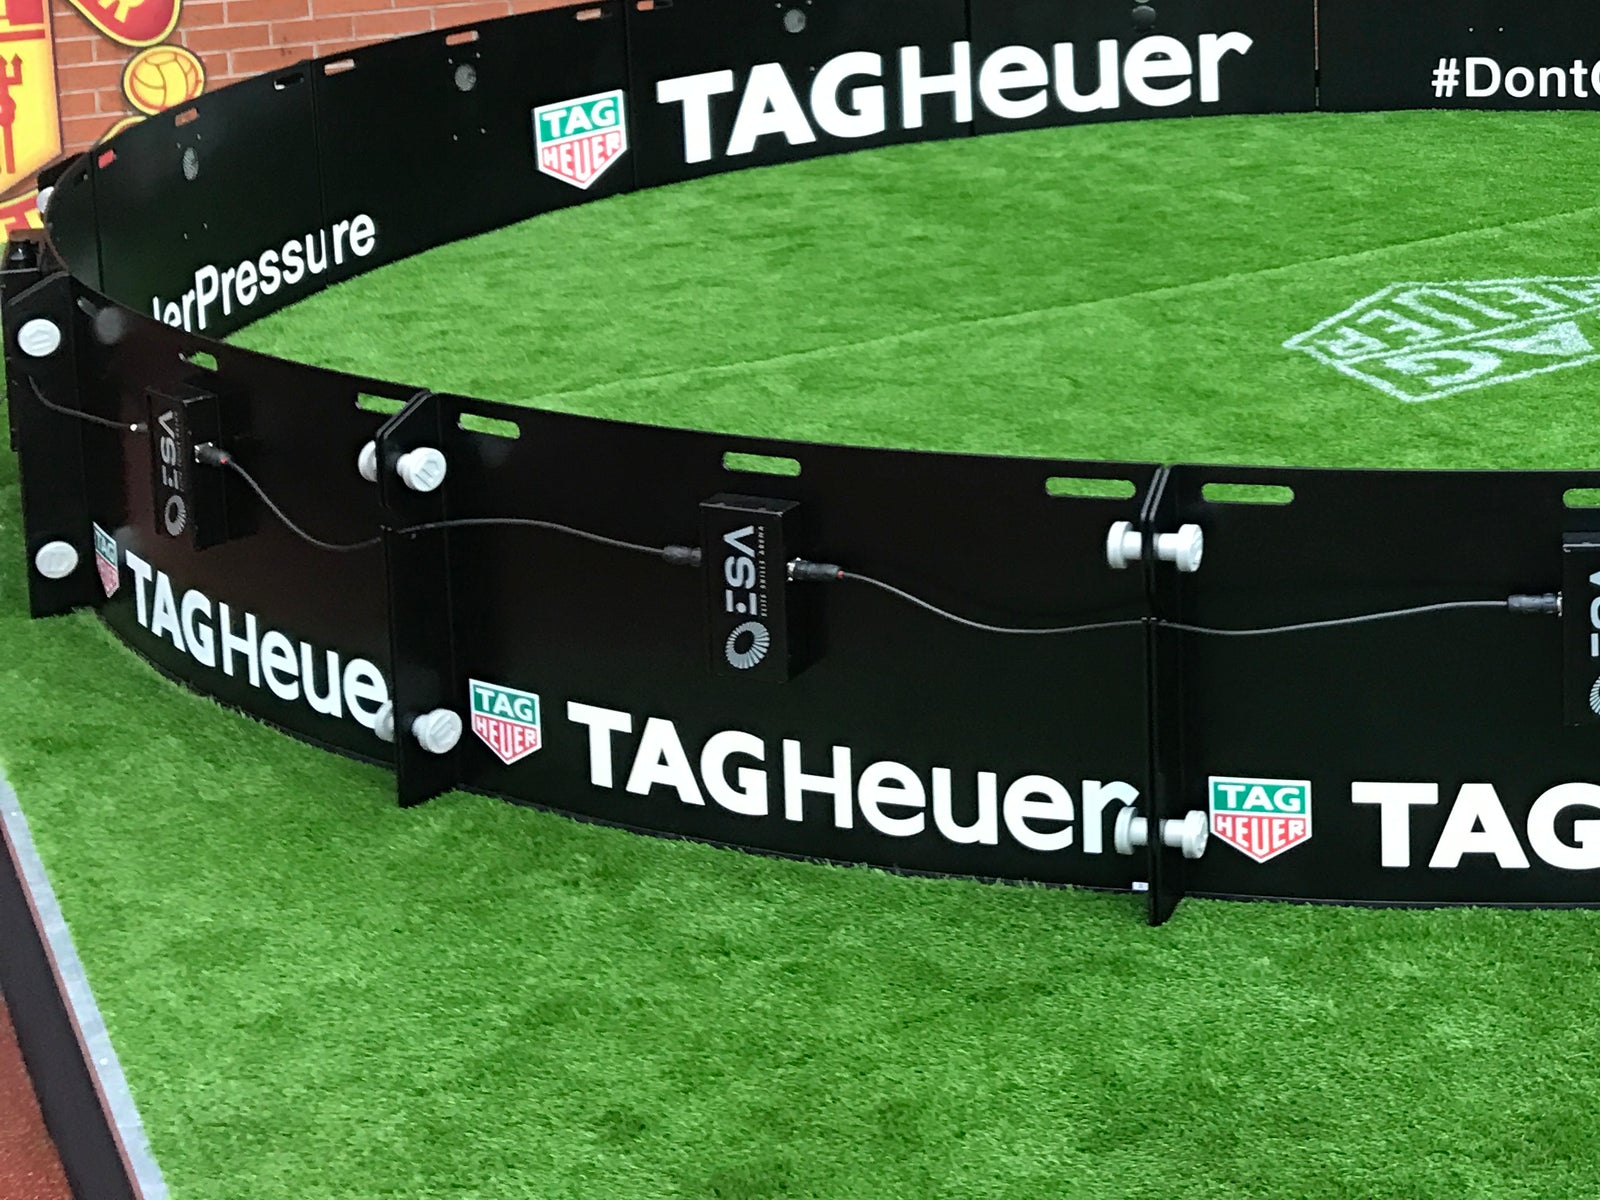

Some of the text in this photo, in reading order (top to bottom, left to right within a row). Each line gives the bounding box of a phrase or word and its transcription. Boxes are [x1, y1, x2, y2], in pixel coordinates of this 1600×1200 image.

[542, 99, 616, 138] TAG
[543, 131, 622, 182] HEUER
[152, 214, 376, 333] erPressure
[476, 687, 534, 723] TAG
[475, 715, 537, 757] HEUER
[1217, 784, 1301, 812] TAG
[1216, 814, 1305, 857] HEUER
